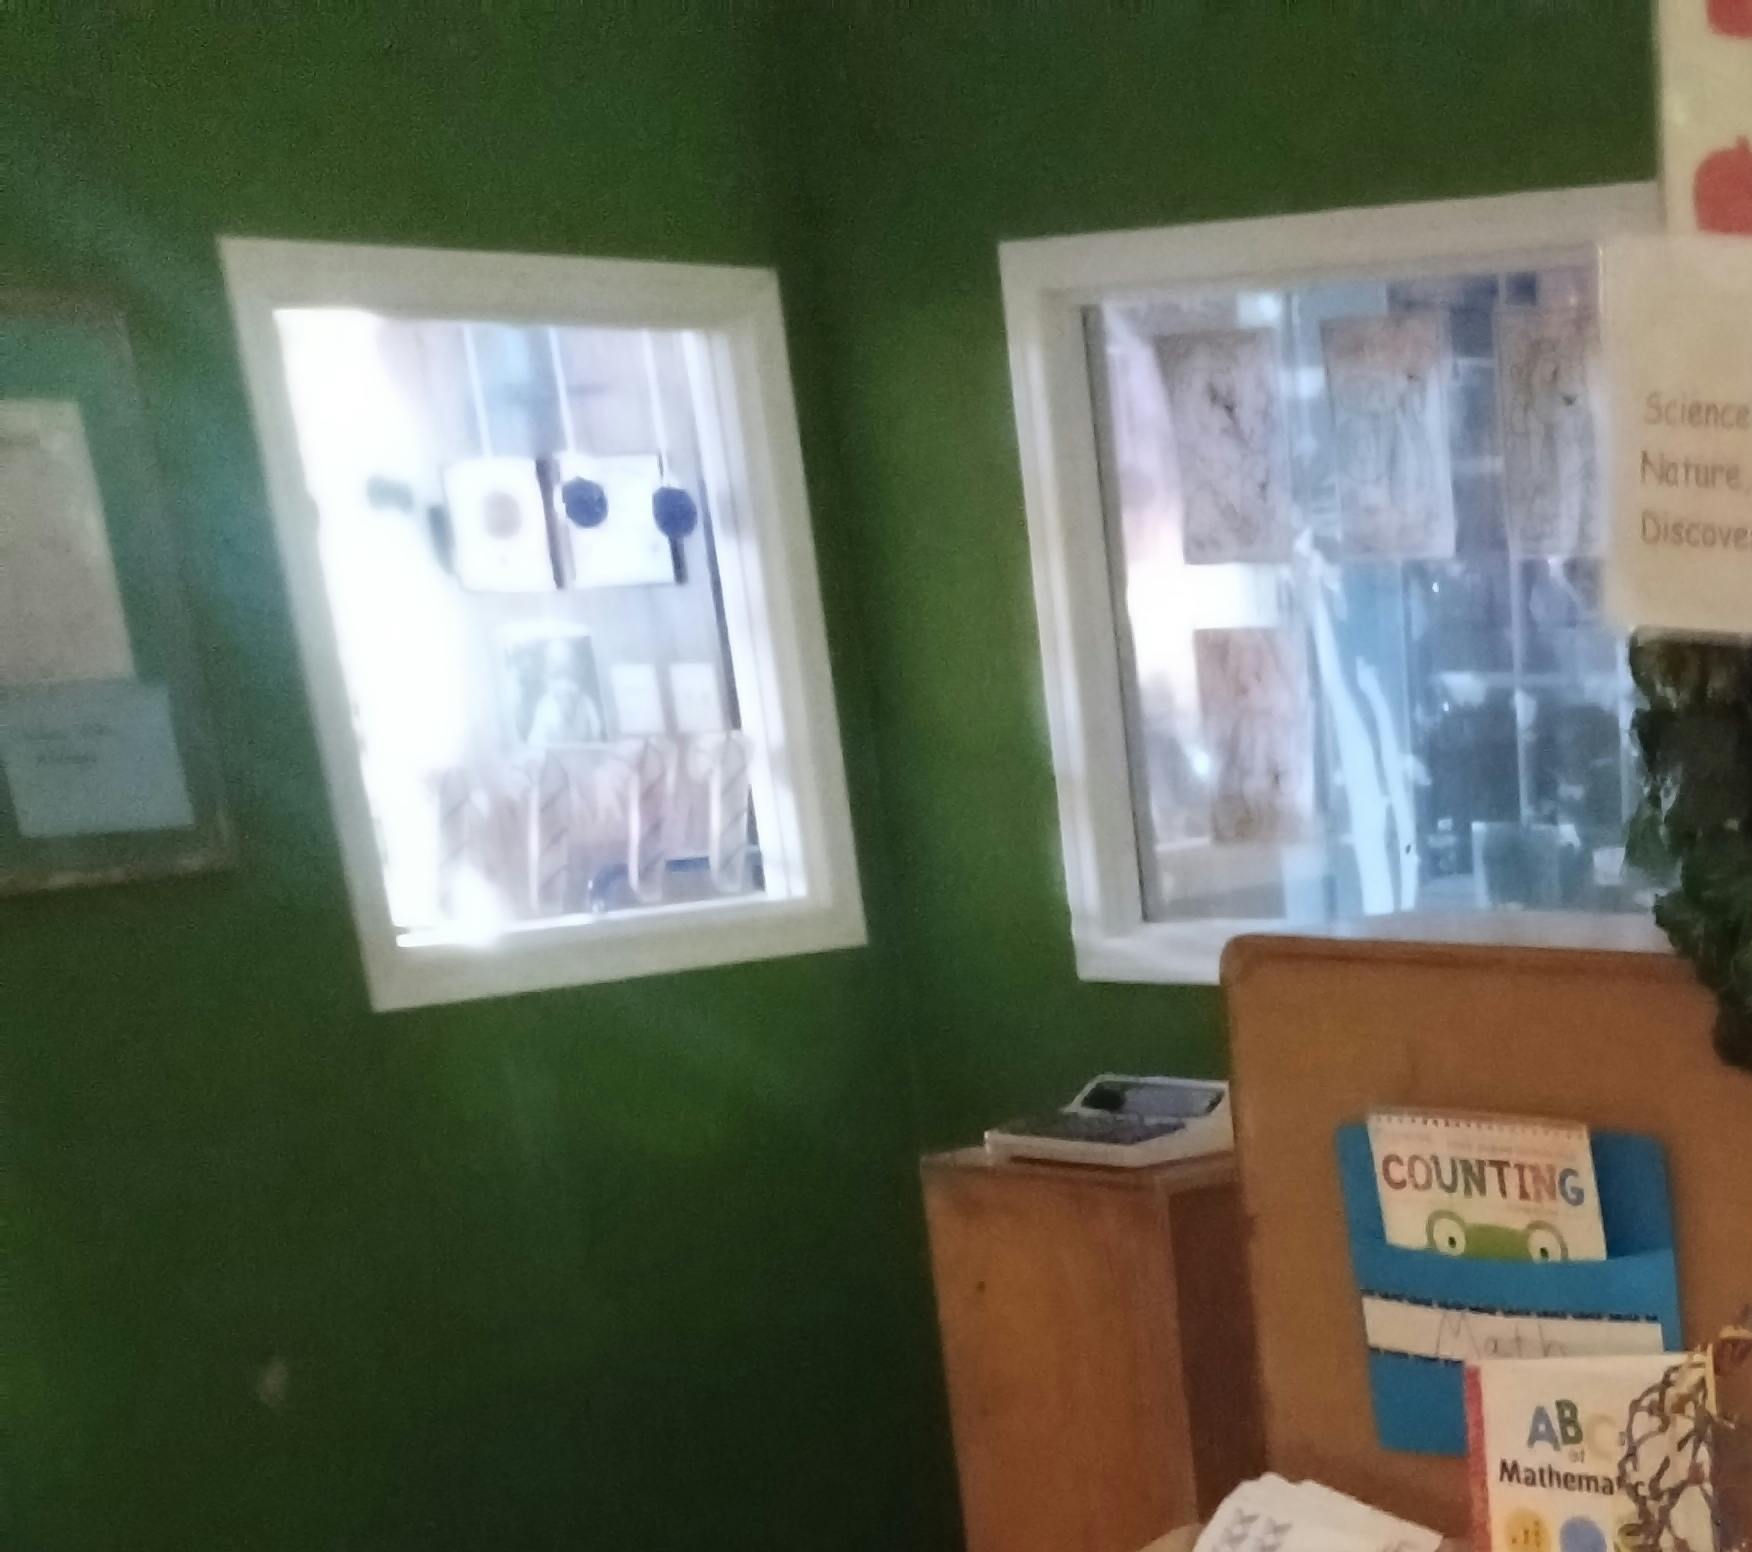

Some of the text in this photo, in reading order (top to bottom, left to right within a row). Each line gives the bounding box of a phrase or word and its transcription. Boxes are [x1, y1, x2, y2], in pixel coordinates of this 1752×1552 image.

[1640, 450, 1752, 495] Nature,
[1382, 1153, 1585, 1206] COUNTING
[1435, 1311, 1569, 1360] Math
